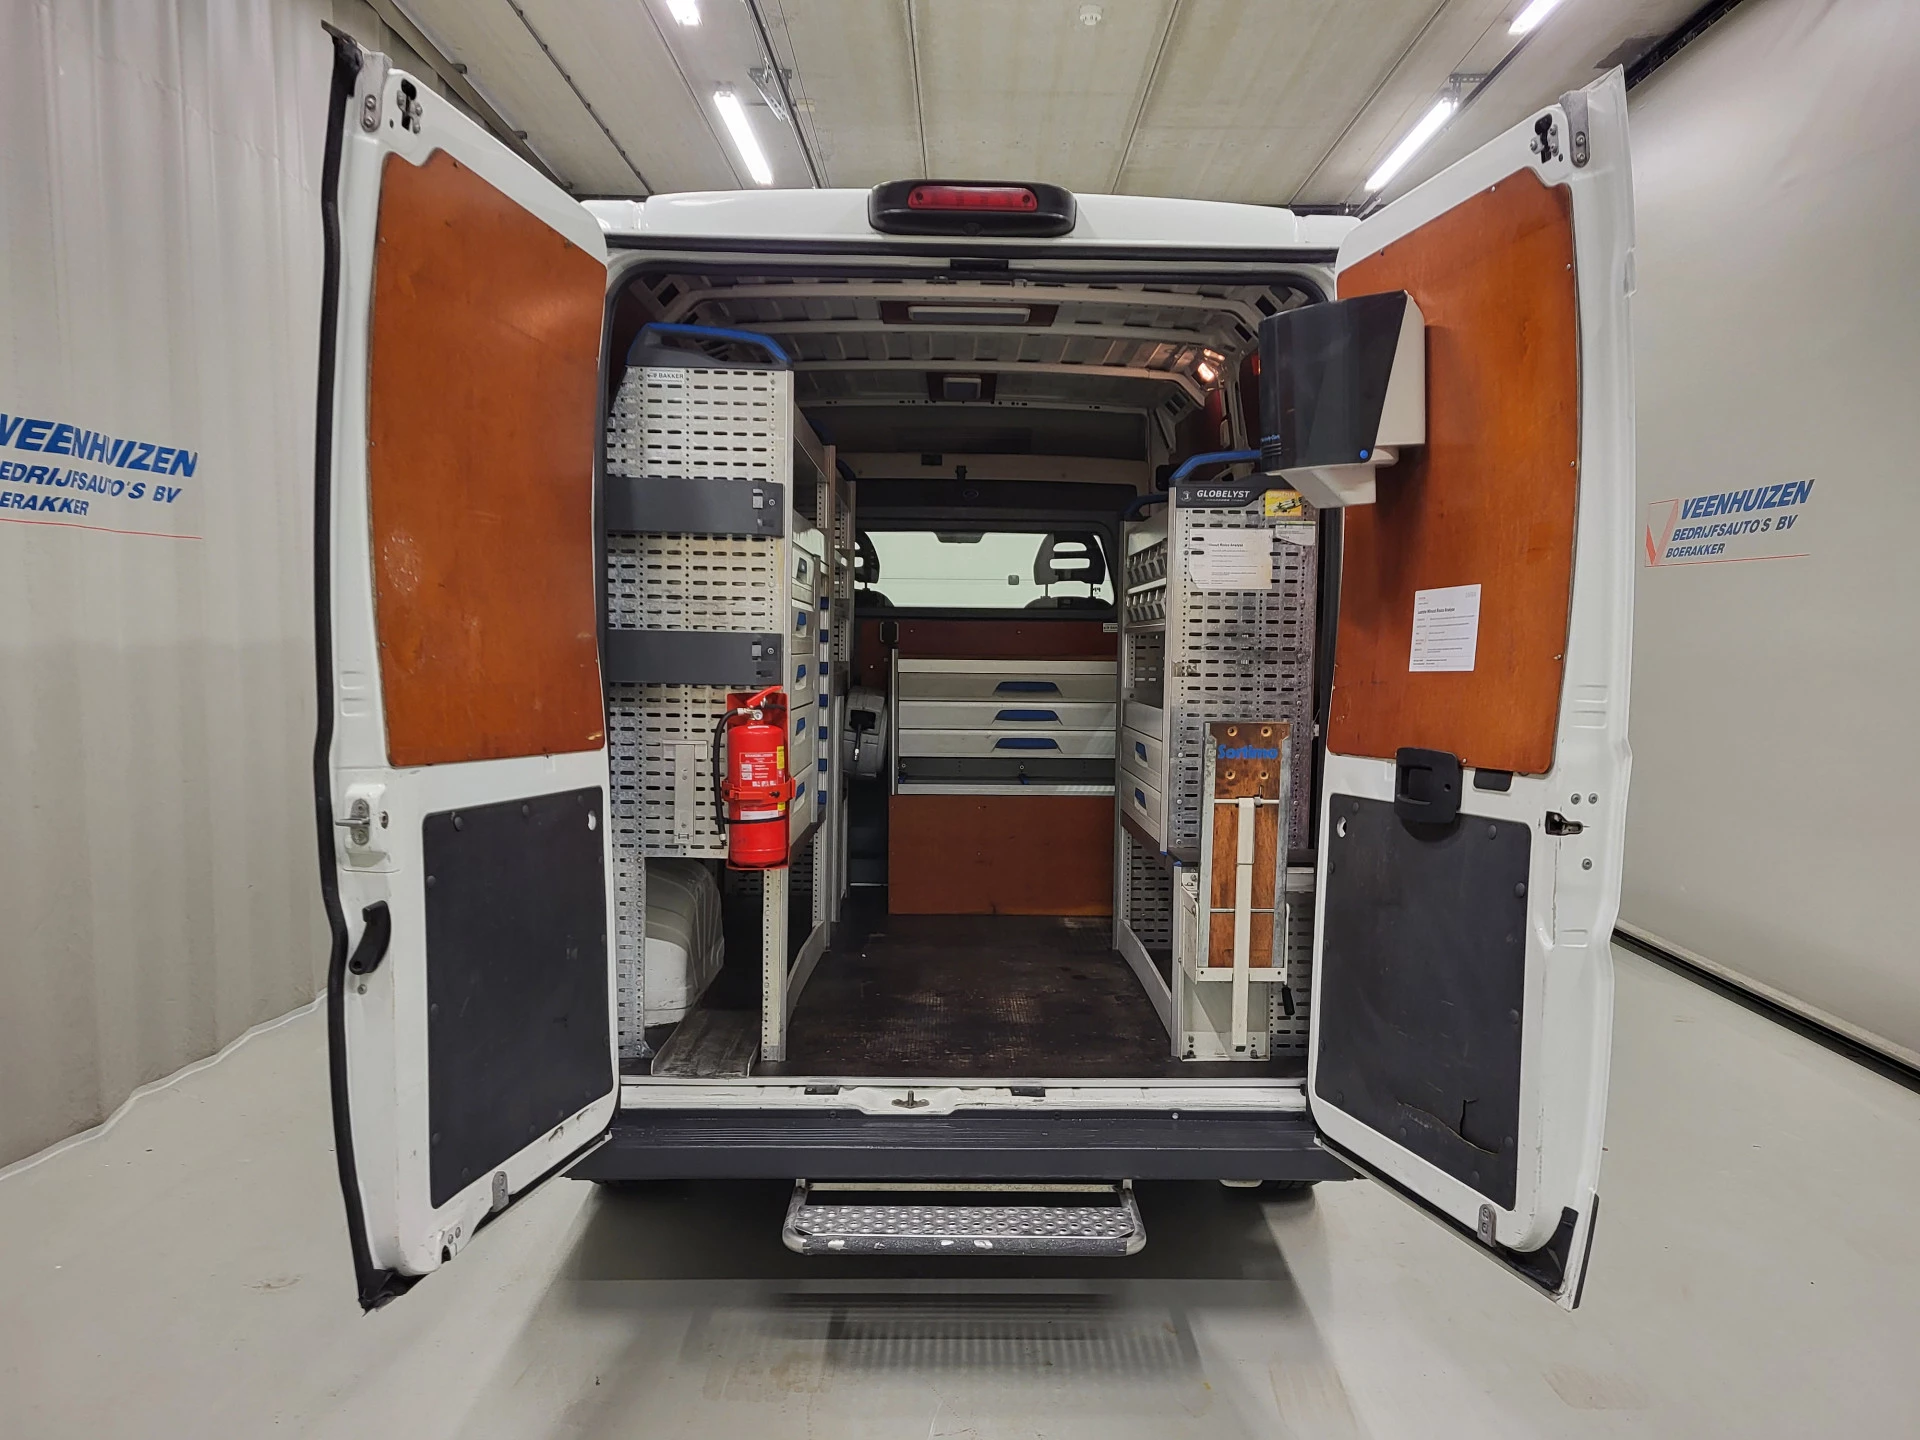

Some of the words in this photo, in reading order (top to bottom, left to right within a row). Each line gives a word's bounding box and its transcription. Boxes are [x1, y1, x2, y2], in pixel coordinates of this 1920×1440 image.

[0, 413, 198, 478] VEENHUIZEN
[152, 485, 182, 503] BV
[1196, 489, 1250, 498] GLOBELYST
[1681, 479, 1815, 520] VEENHUIZEN
[1672, 519, 1771, 541] BEDRIJFSAUTO'S
[1775, 514, 1798, 531] BV
[1666, 543, 1725, 559] BOERAKKER
[1218, 744, 1278, 759] Sortimo
